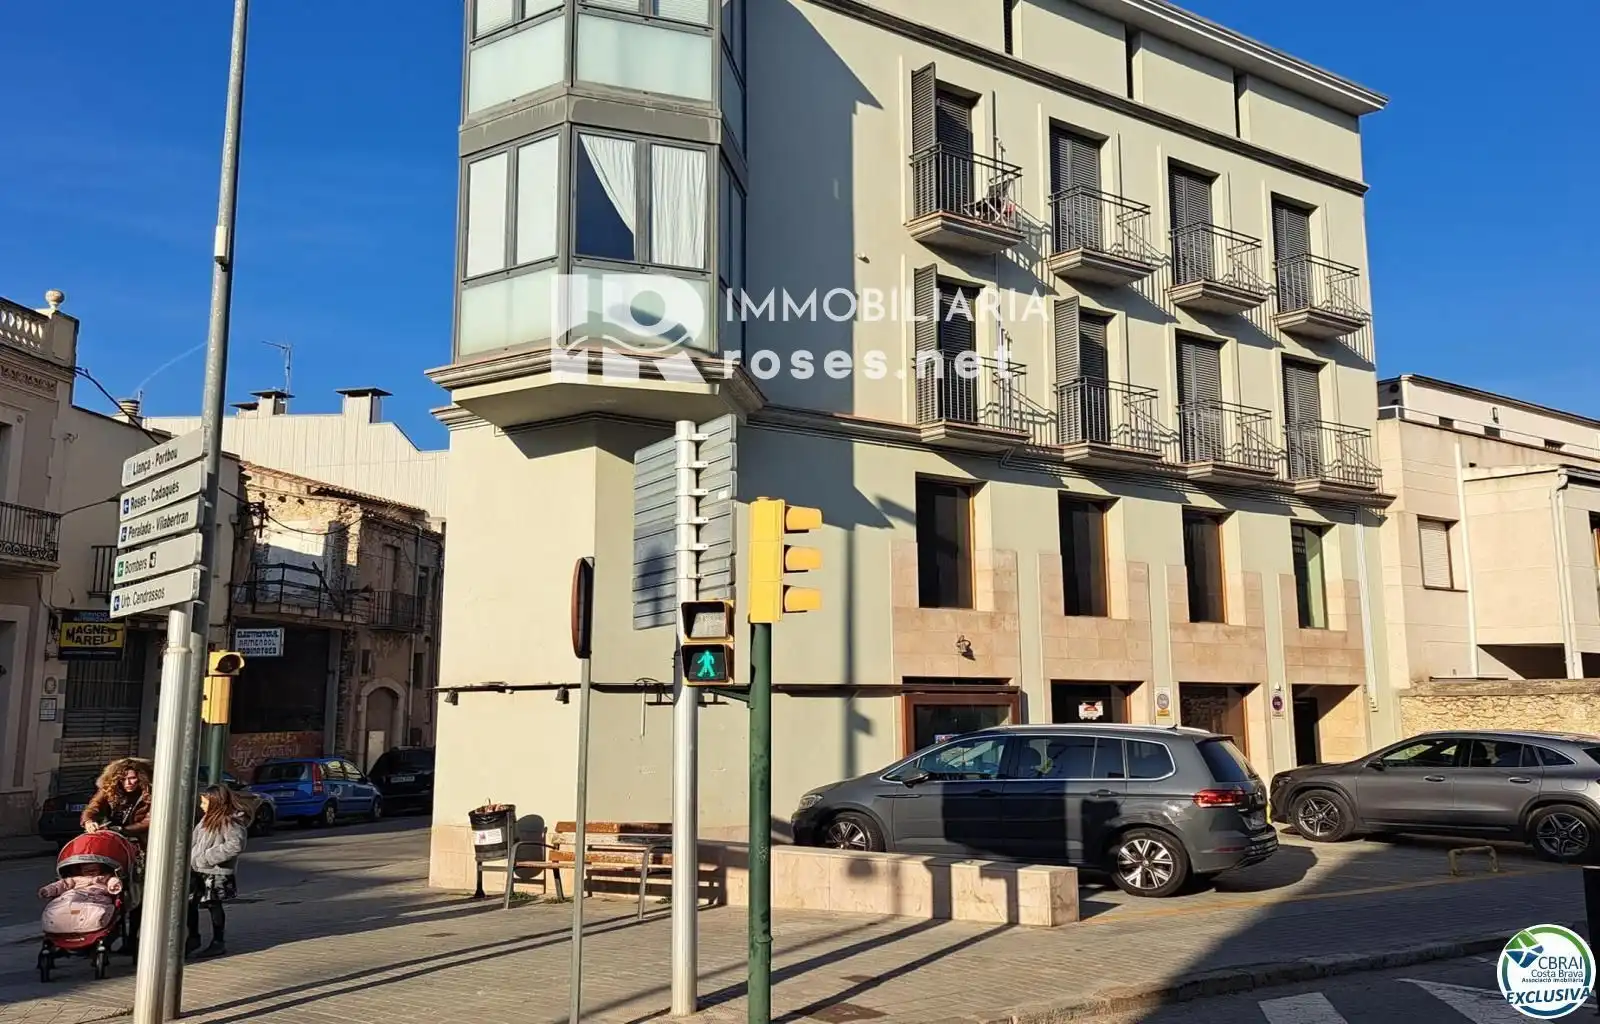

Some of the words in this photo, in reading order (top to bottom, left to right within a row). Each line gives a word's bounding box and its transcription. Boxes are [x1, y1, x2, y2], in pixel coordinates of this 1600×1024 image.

[155, 448, 178, 467] Portbou
[131, 495, 147, 511] Roses
[128, 521, 152, 540] Peralada
[156, 511, 189, 531] Vilabertran
[124, 557, 148, 575] Bombers
[121, 594, 131, 609] Urb.
[132, 586, 166, 605] Cendrassos
